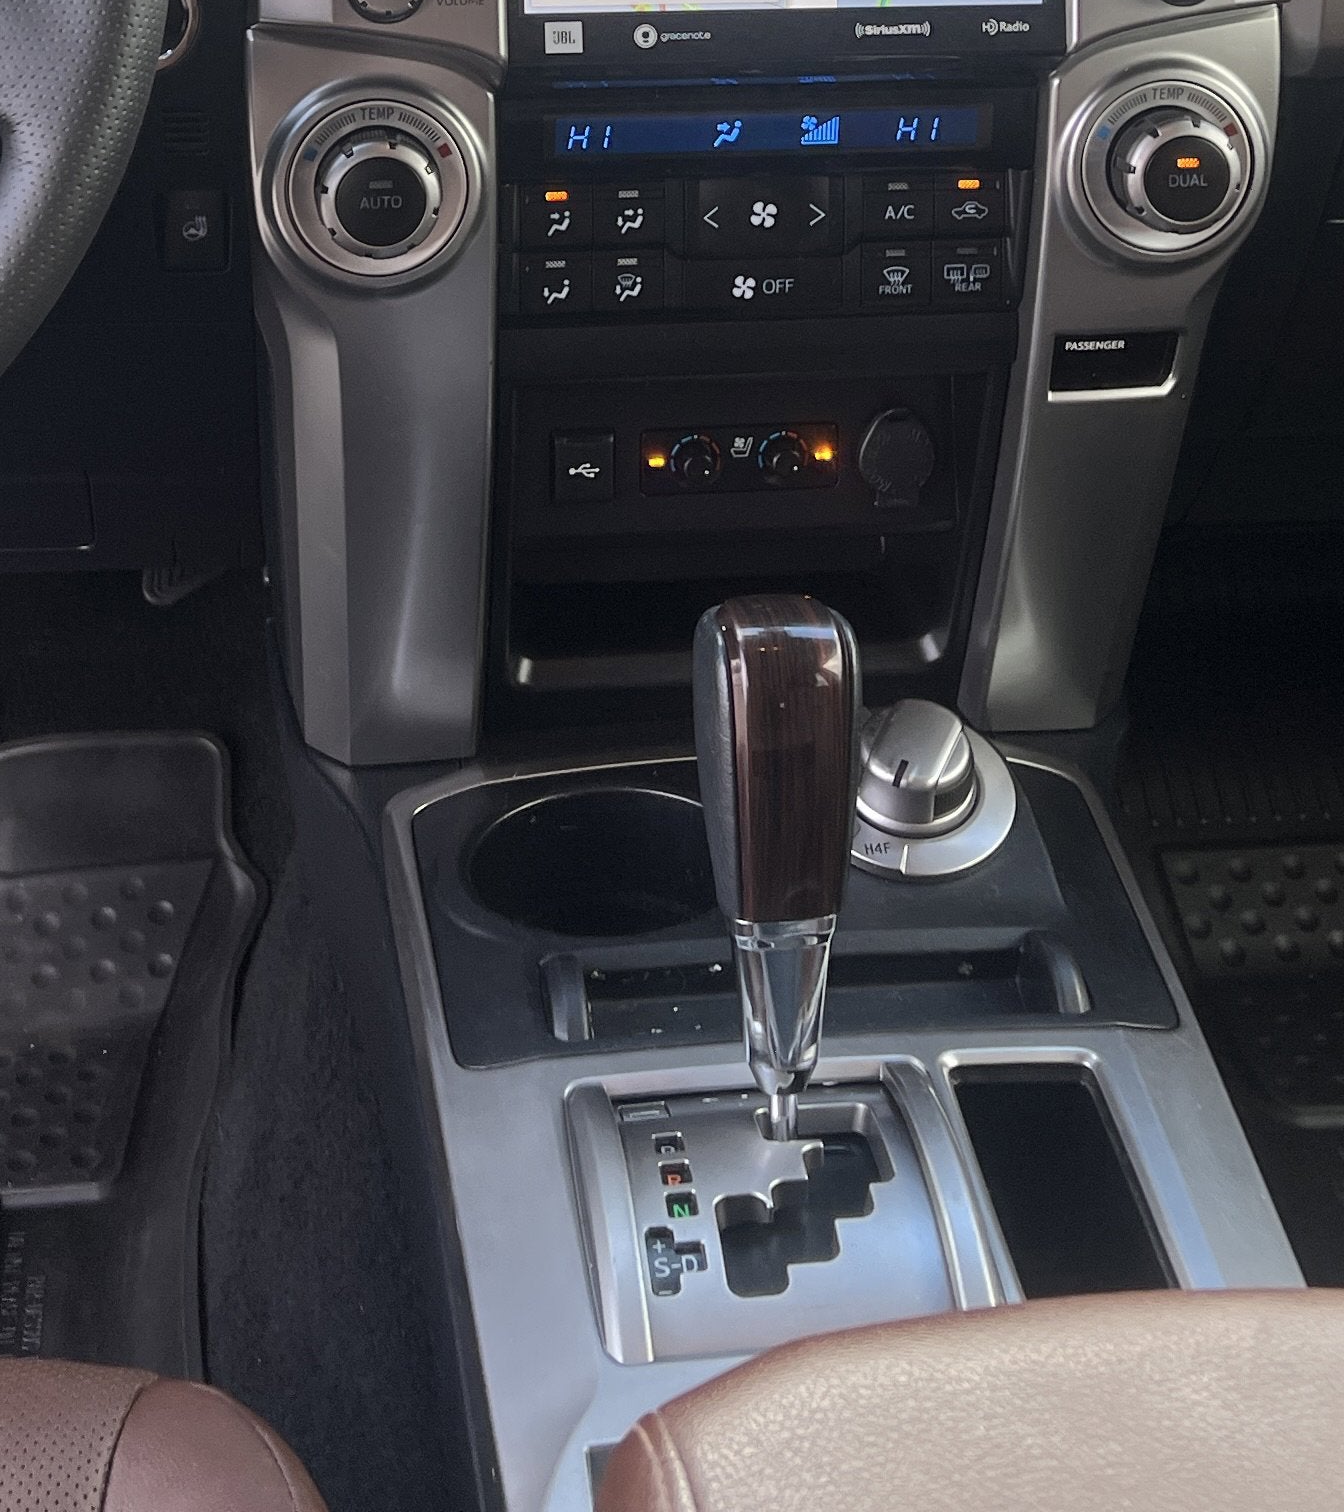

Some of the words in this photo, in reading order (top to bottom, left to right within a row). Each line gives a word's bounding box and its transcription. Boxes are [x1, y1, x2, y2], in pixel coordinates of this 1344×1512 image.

[999, 21, 1030, 34] Radio
[552, 29, 576, 45] JBL
[660, 30, 712, 44] gracenote
[1151, 87, 1185, 101] TEMP
[360, 107, 395, 121] TEMP
[1168, 174, 1208, 187] DUAL
[360, 196, 403, 209] AUTO
[884, 204, 915, 220] A/C
[762, 278, 794, 294] OFF
[878, 284, 913, 295] FRONT
[955, 282, 982, 292] REAR
[1065, 340, 1126, 351] PASSENGER
[865, 842, 891, 855] H4F
[672, 1204, 690, 1218] N
